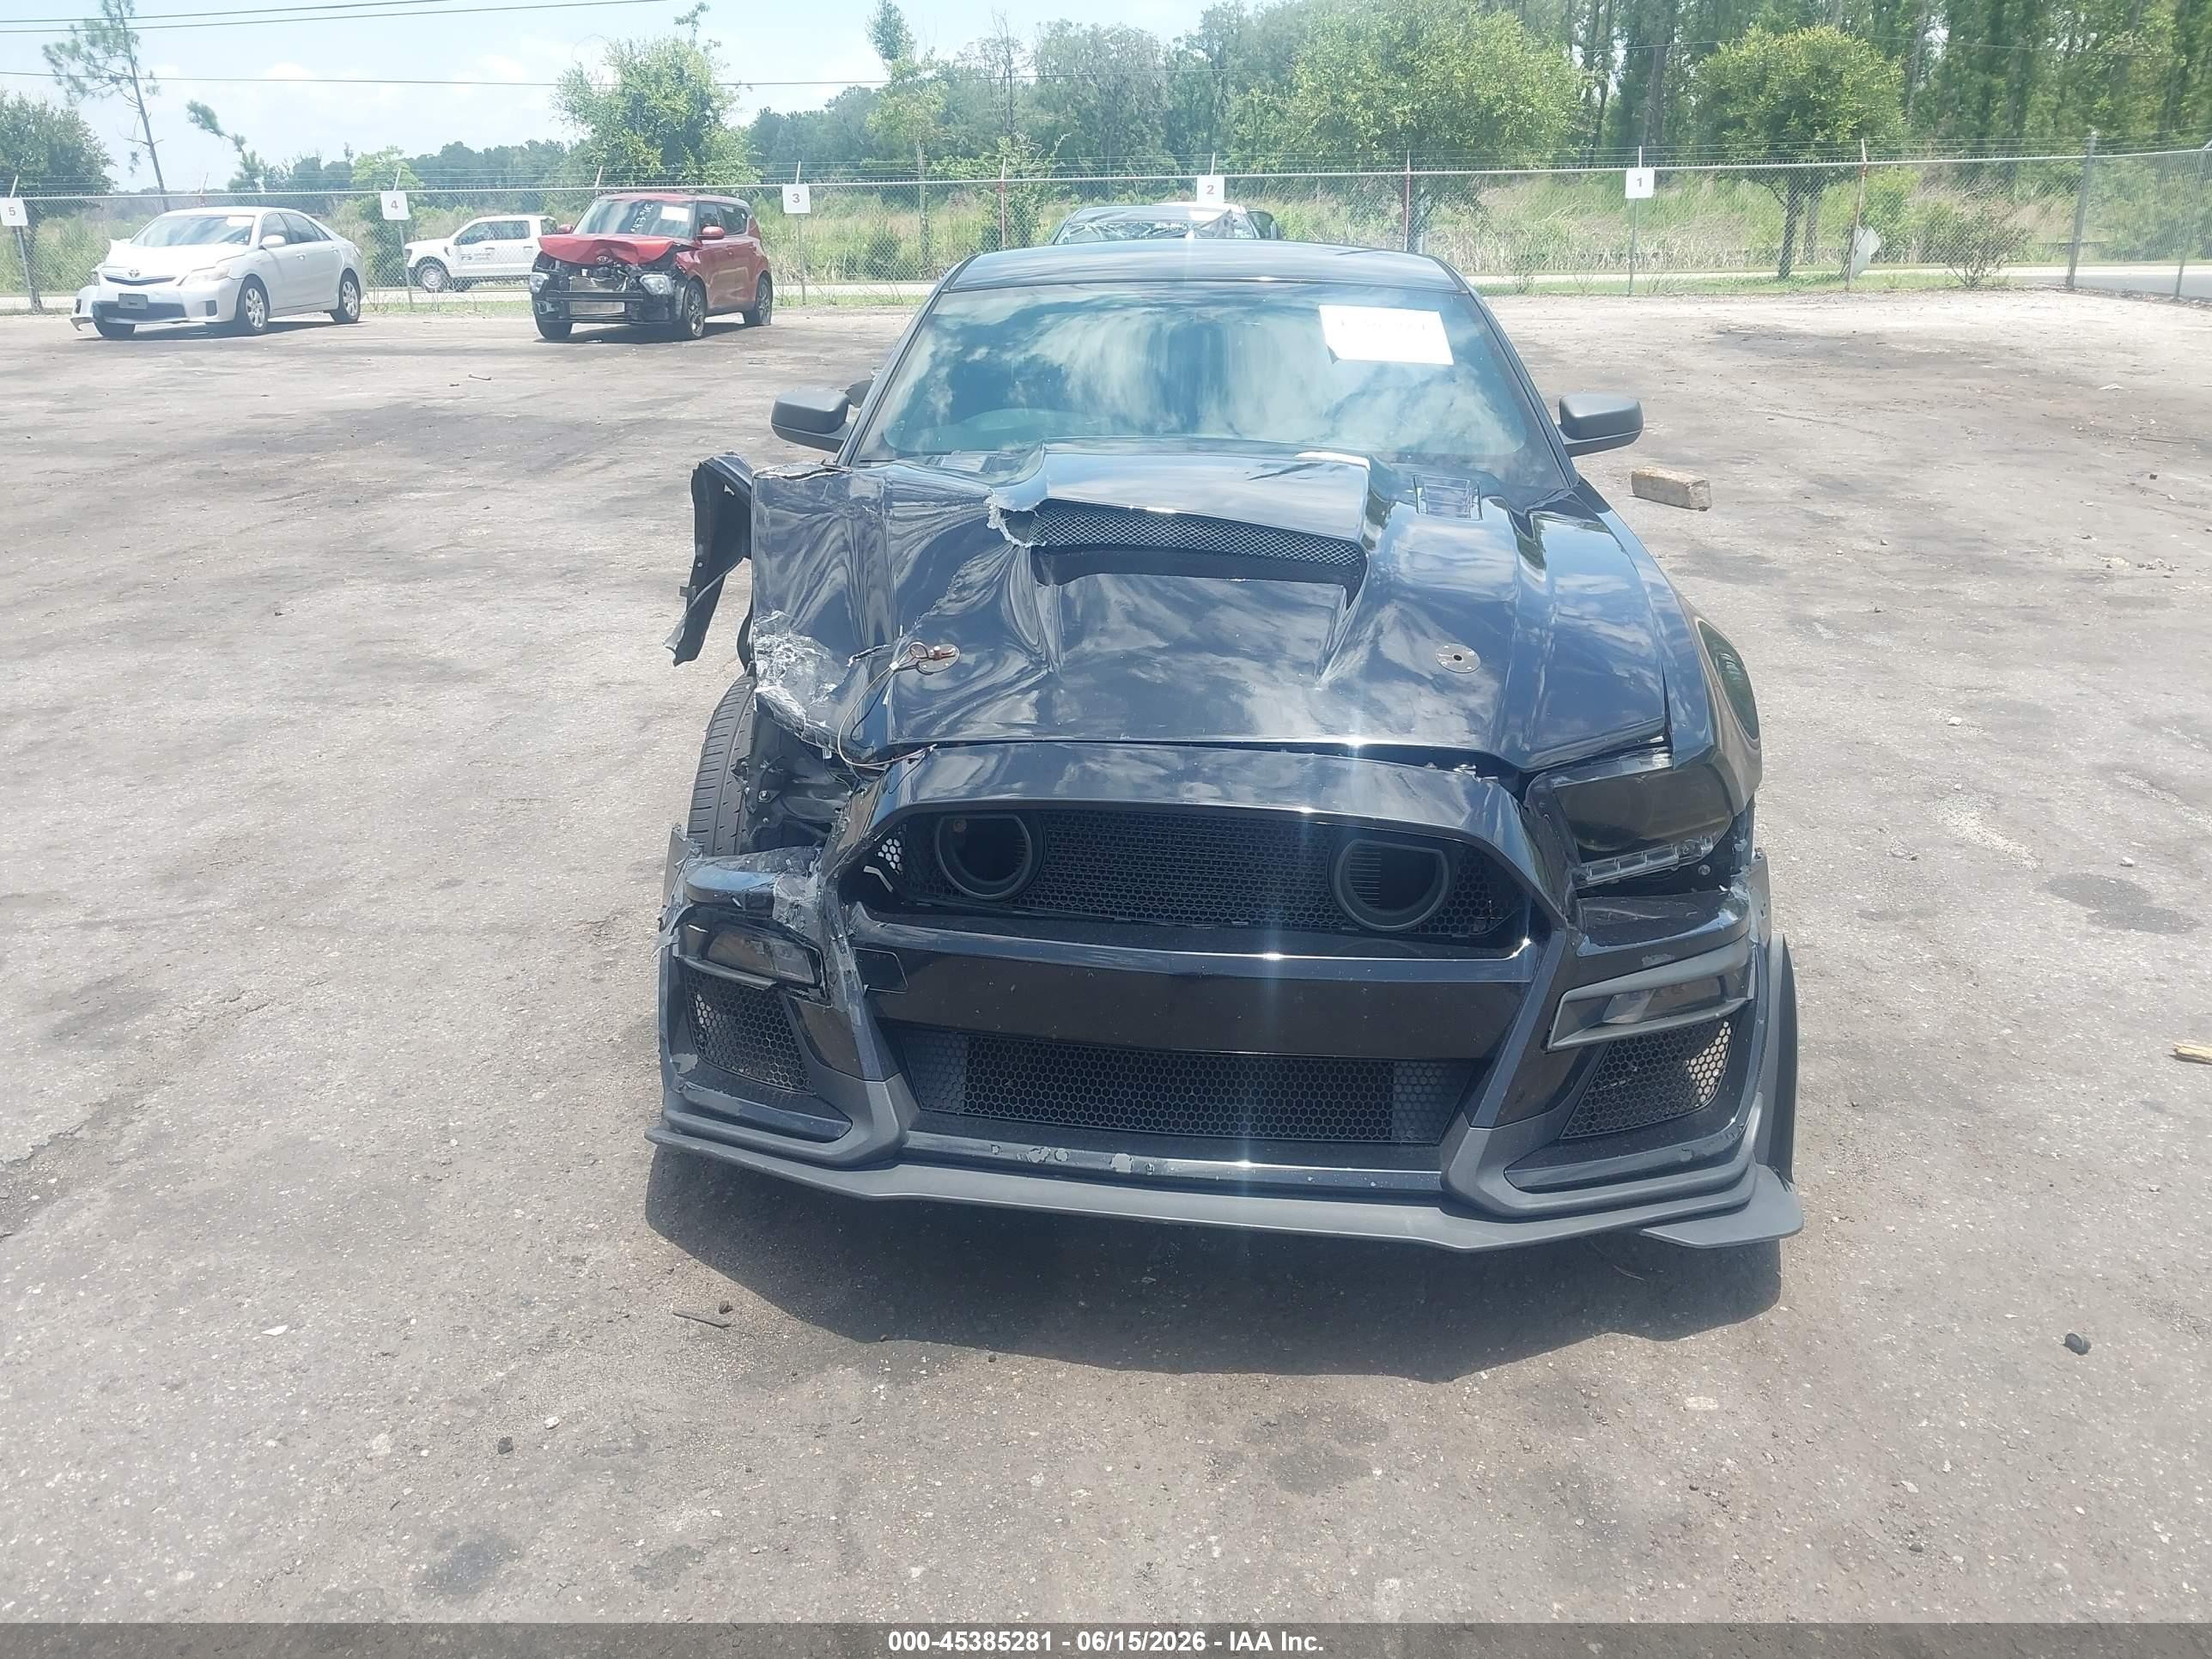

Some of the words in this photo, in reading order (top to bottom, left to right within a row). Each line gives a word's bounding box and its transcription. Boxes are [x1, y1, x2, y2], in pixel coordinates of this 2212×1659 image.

[1636, 177, 1644, 188] 1
[1206, 185, 1214, 196] 2
[792, 192, 800, 204] 3
[391, 199, 399, 210] 4
[8, 206, 16, 216] 5
